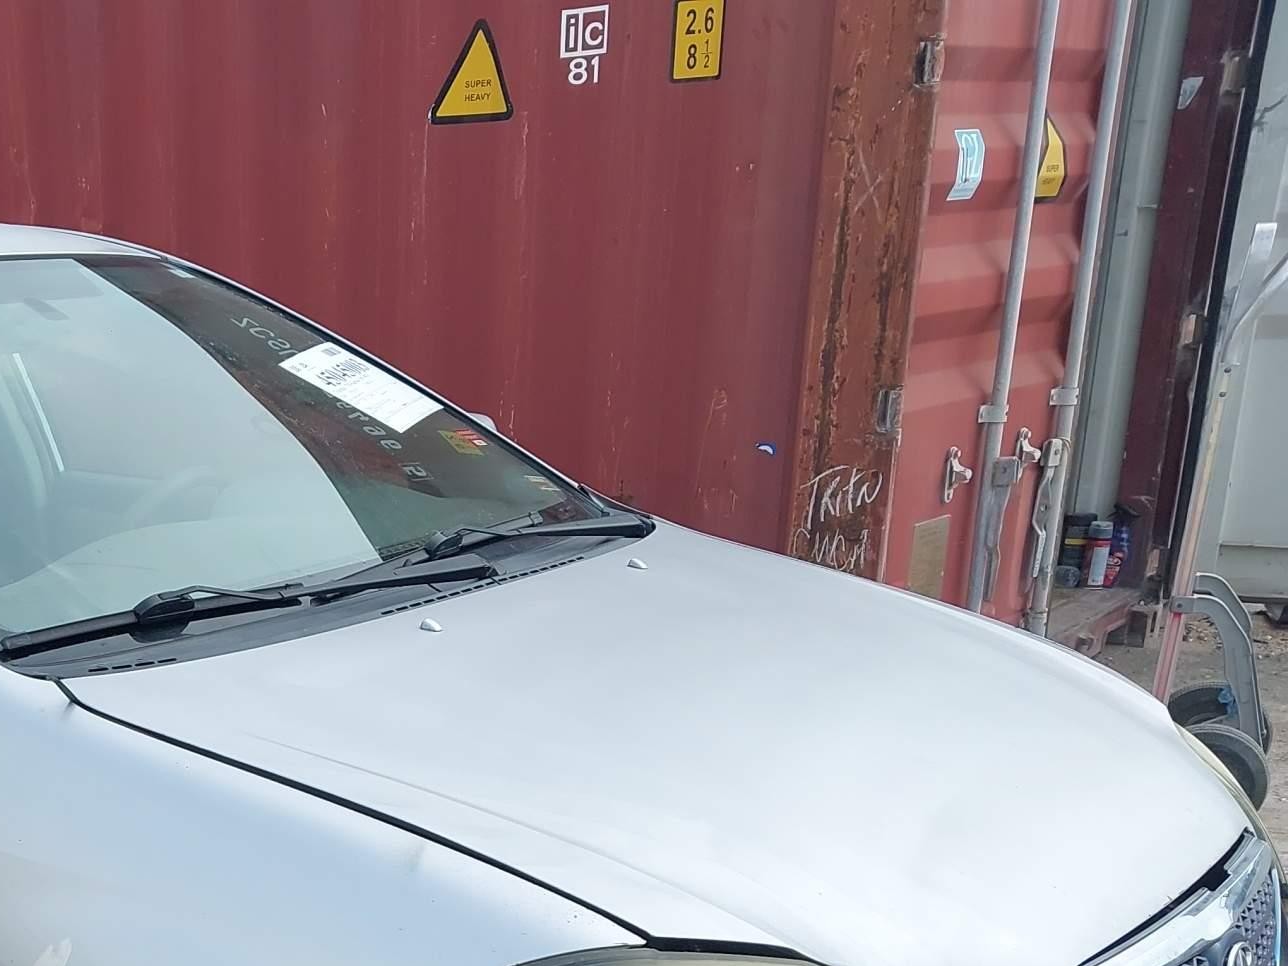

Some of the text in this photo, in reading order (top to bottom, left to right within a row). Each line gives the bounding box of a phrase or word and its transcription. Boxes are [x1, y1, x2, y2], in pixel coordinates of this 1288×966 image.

[684, 6, 715, 36] 2.6
[567, 55, 600, 85] 81
[464, 79, 492, 89] SUPER
[464, 92, 492, 102] HEAVY
